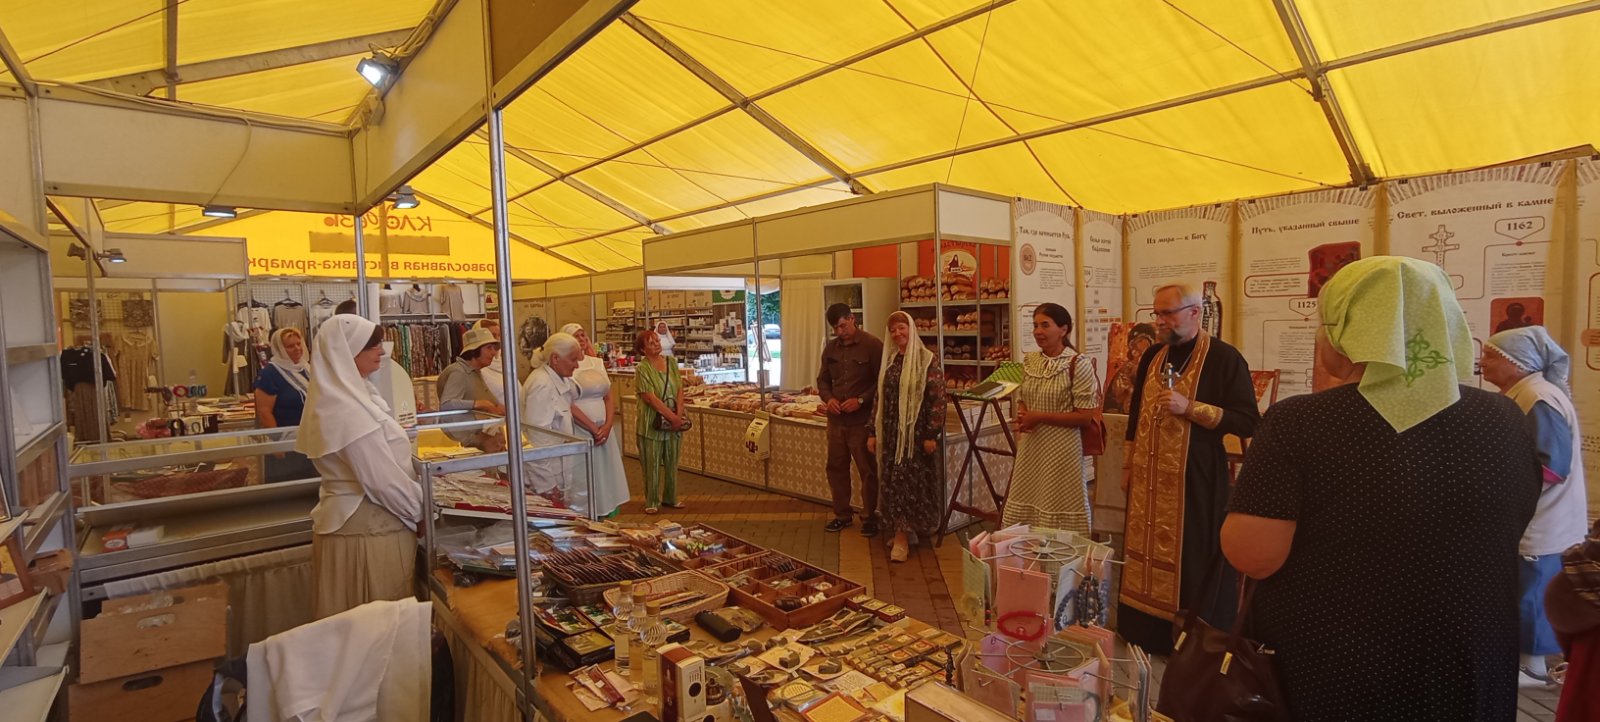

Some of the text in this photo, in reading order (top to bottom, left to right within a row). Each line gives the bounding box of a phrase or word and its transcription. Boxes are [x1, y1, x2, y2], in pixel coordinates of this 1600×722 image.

[1397, 211, 1427, 219] Свет,
[1431, 201, 1502, 215] выложенный
[1517, 197, 1554, 207] камне
[1252, 219, 1360, 235] Путь, указанный свыше
[1507, 221, 1533, 231] 1162
[1297, 301, 1317, 309] 1125
